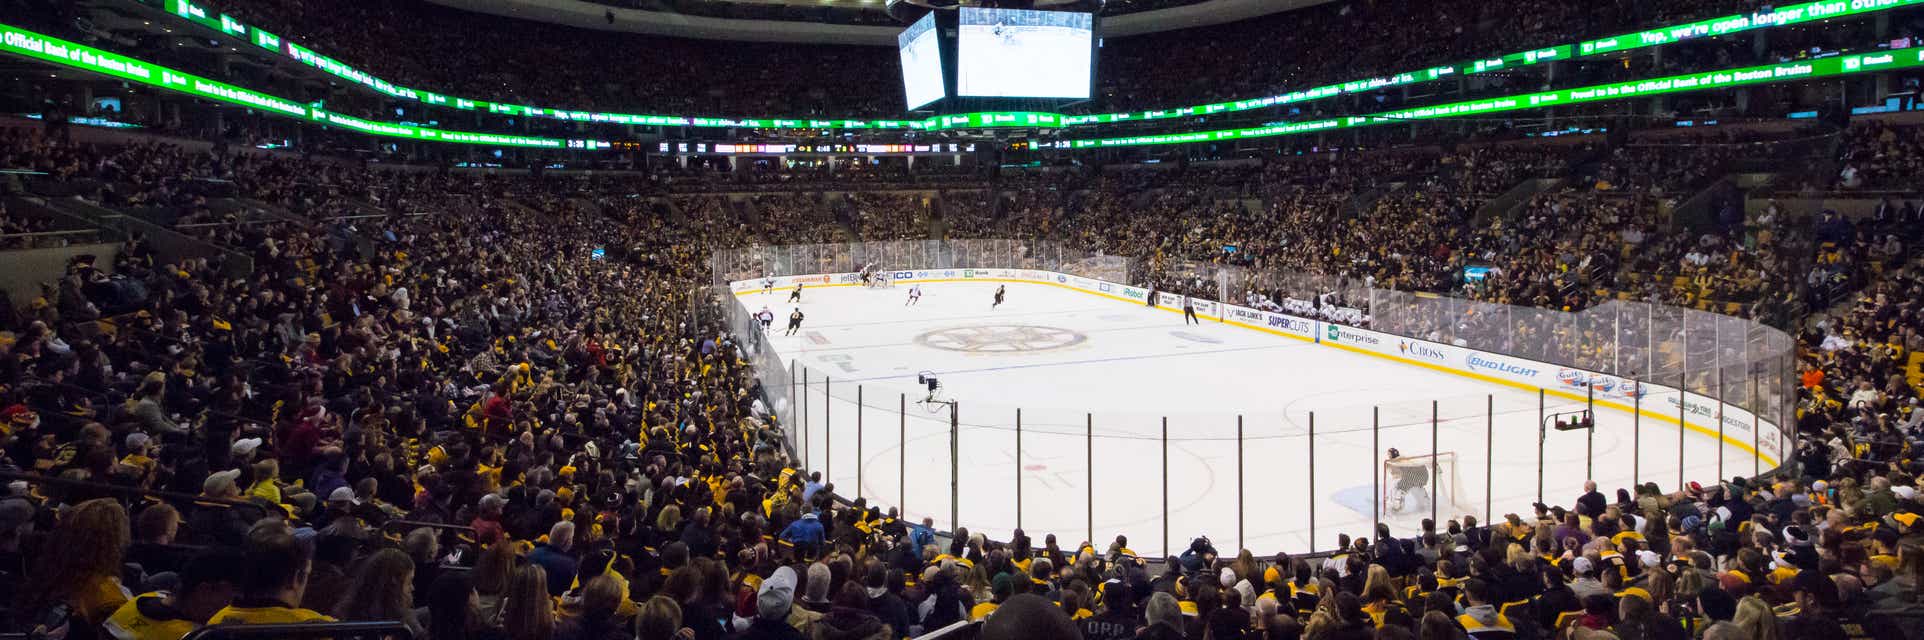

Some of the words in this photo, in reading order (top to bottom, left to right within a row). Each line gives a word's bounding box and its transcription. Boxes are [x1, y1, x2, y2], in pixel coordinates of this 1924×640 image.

[1641, 31, 1667, 43] Yep,
[1671, 24, 1708, 39] we're
[1712, 17, 1748, 32] open
[1752, 8, 1804, 25] longer
[1808, 0, 1846, 17] than
[4, 31, 43, 52] Official
[1845, 57, 1860, 69] TD
[1863, 54, 1893, 65] Bank
[1597, 88, 1606, 96] to
[1607, 86, 1618, 95] be
[1621, 84, 1636, 93] the
[1637, 80, 1671, 92] Official
[1700, 74, 1712, 84] of
[1714, 72, 1732, 83] the
[1734, 69, 1772, 81] Boston
[1775, 64, 1812, 76] Bruins
[1268, 315, 1309, 334] SUPERCUTS
[1559, 370, 1578, 379] Gulf
